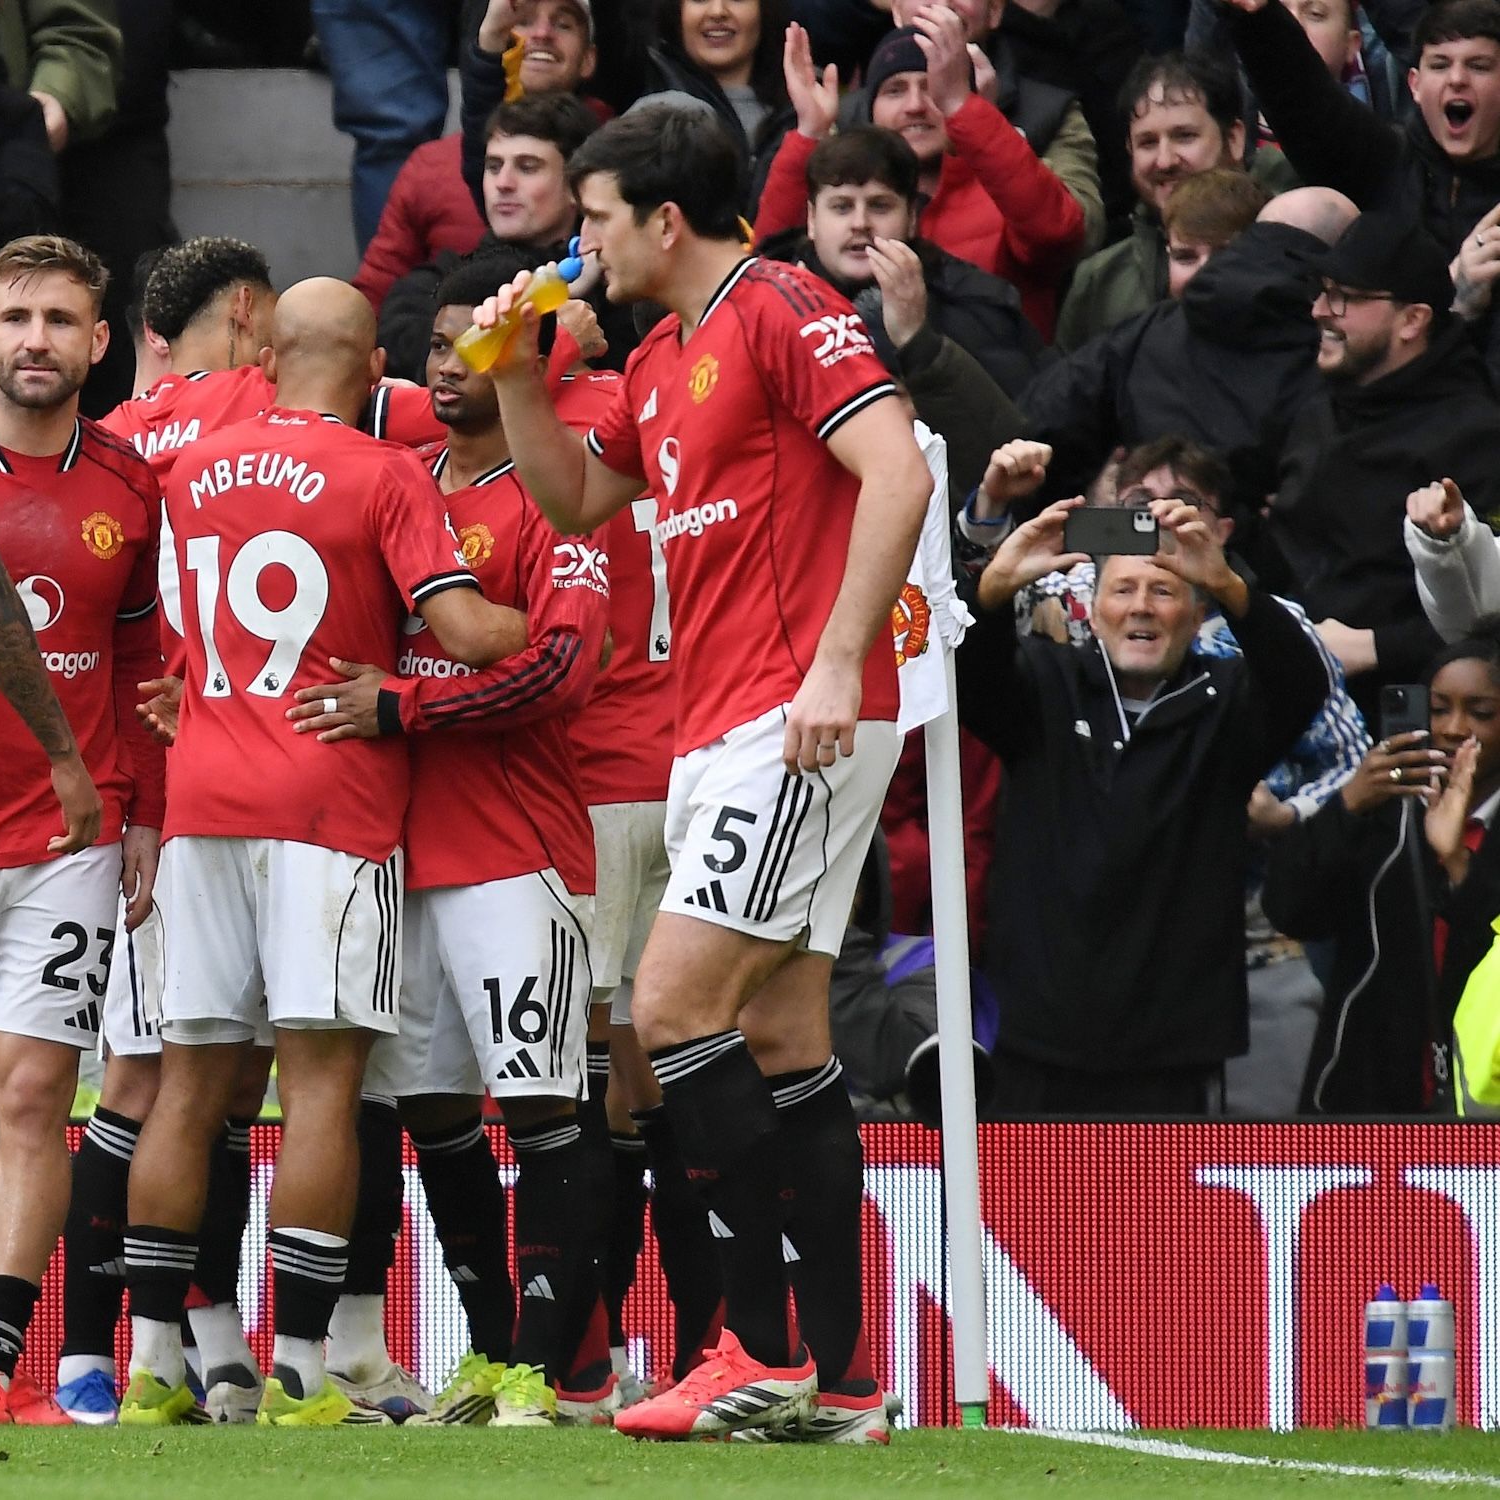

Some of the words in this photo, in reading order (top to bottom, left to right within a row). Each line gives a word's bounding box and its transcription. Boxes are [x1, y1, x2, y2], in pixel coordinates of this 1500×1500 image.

[189, 453, 326, 510] MBEUMO
[186, 530, 330, 698] 19
[902, 587, 926, 649] CHESTER
[703, 805, 758, 874] 5
[41, 921, 116, 997] 23
[483, 976, 548, 1044] 16
